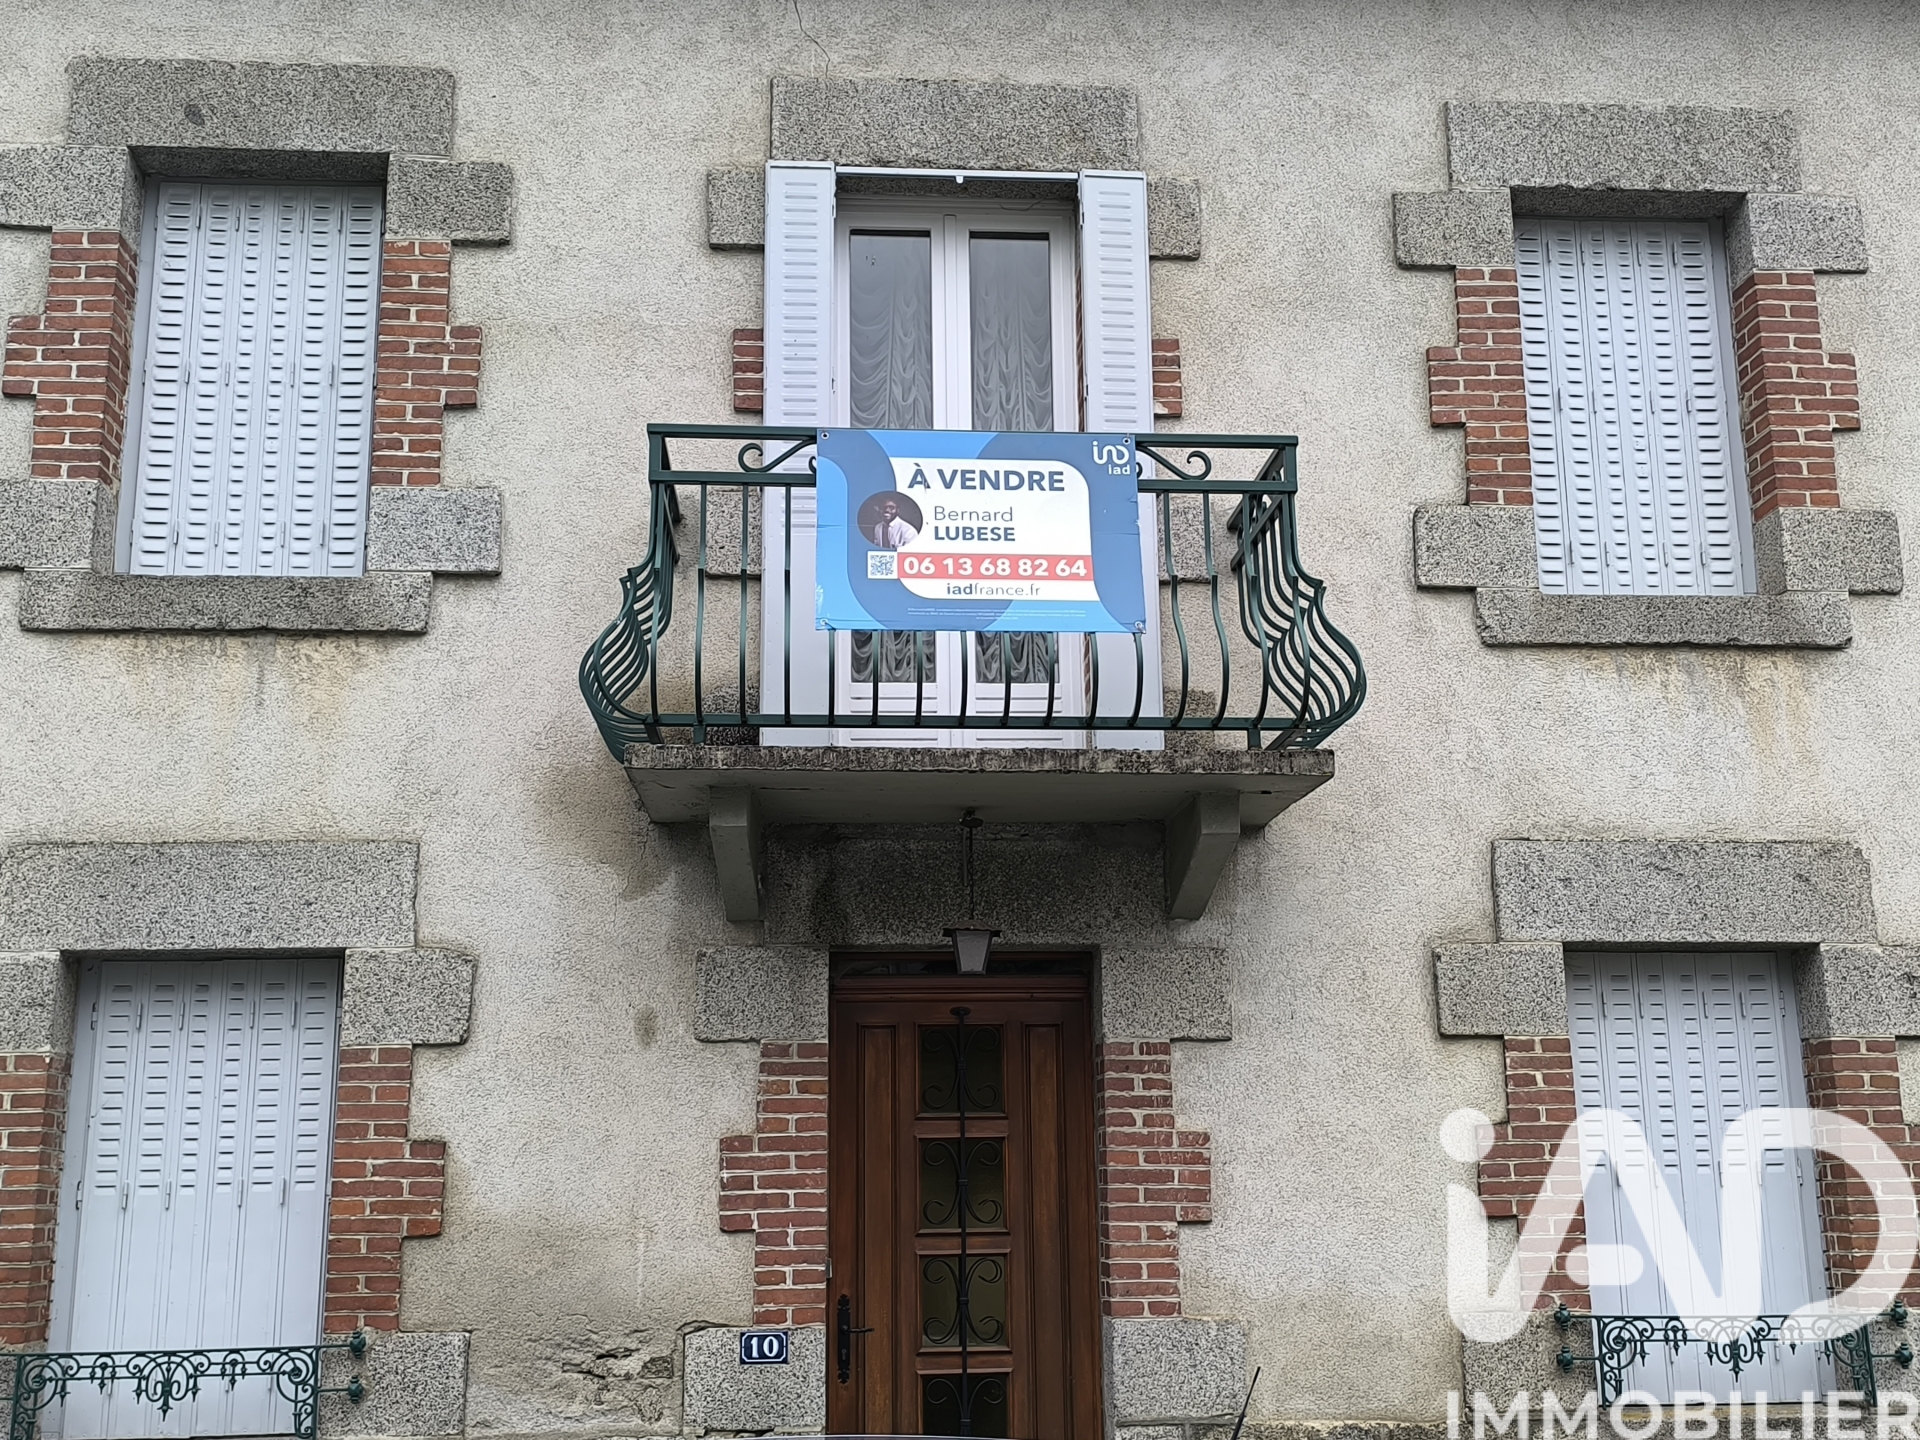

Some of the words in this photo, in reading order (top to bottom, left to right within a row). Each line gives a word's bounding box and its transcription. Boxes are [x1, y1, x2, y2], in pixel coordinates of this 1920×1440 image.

[907, 462, 931, 490] À
[936, 467, 1065, 492] VENDRE
[1108, 464, 1131, 475] iad
[933, 505, 1014, 522] Bernard
[933, 525, 1016, 542] LUBESE
[903, 556, 936, 575] 06
[942, 557, 973, 576] 13
[979, 557, 1011, 577] 68
[1017, 557, 1050, 577] 82
[1055, 558, 1088, 577] 64
[946, 582, 1041, 597] iadfrance.fr
[750, 1335, 779, 1358] 10
